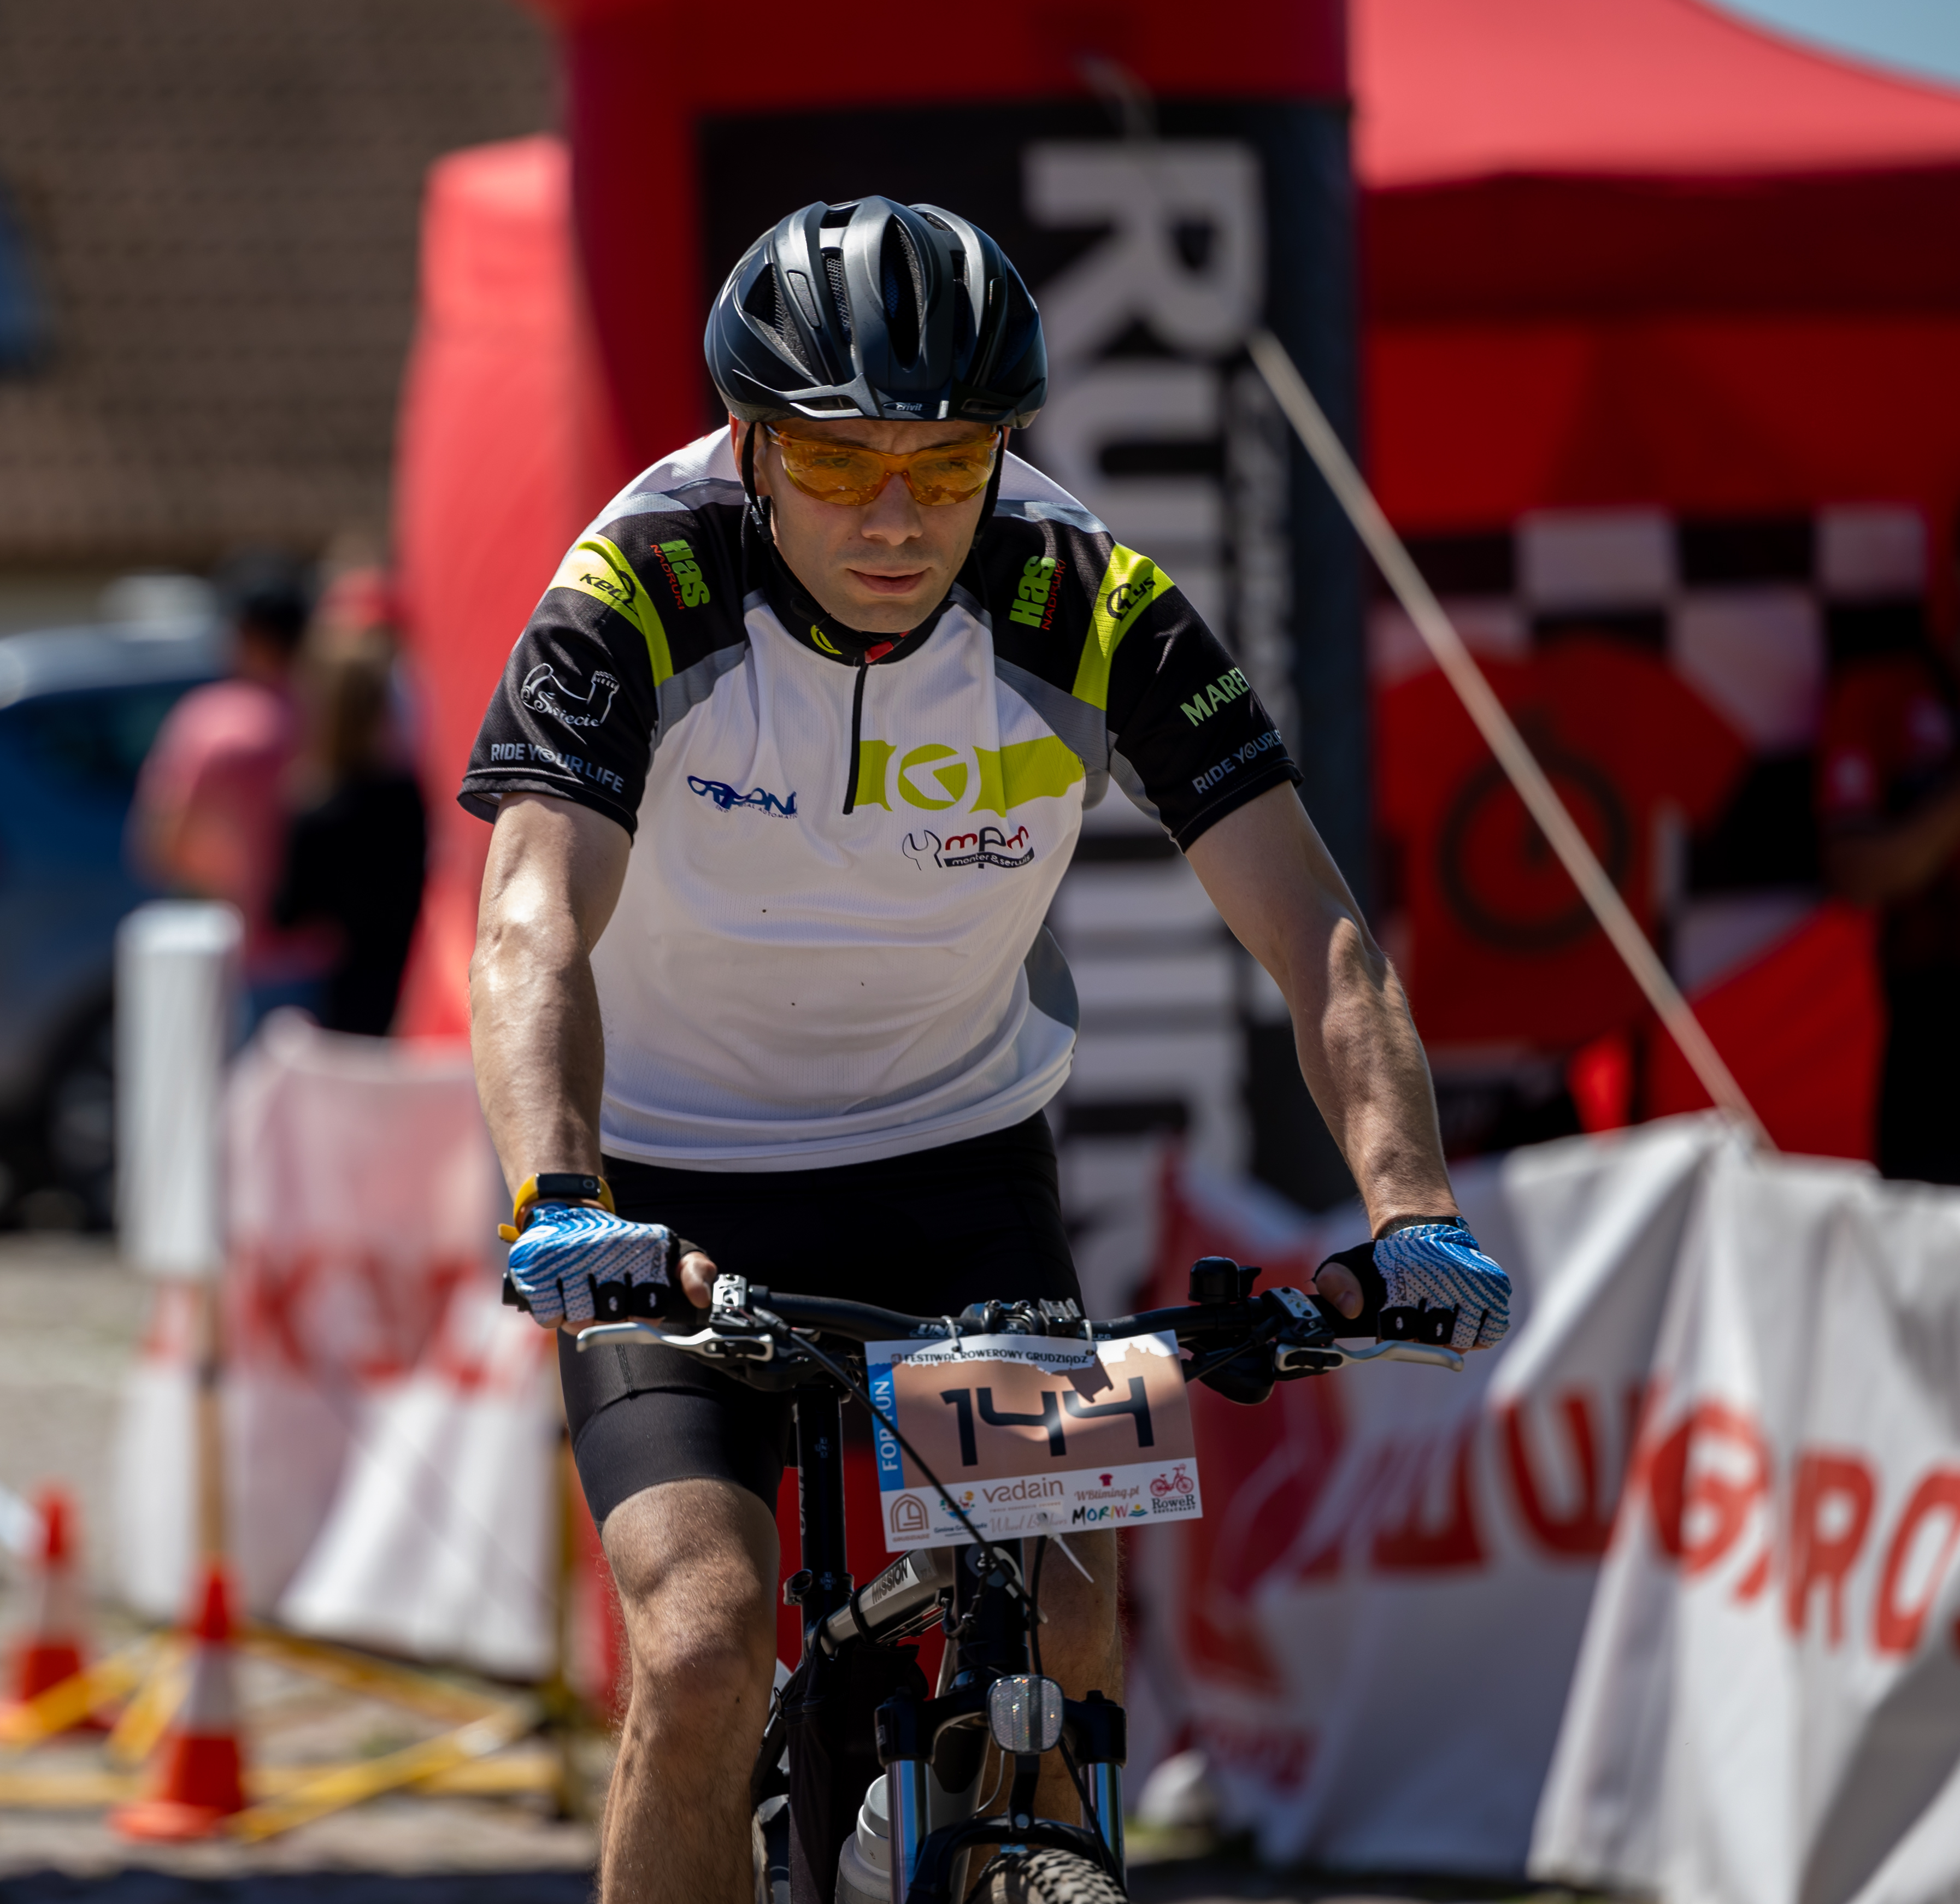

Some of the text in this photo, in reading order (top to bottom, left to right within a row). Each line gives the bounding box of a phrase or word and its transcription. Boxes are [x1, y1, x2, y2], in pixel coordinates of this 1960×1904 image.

[650, 545, 685, 610] NADRUKI
[1041, 559, 1067, 630] NADRUKI
[491, 743, 625, 793] RIDE YOUR LIFE
[1192, 758, 1236, 794] RIDE
[1232, 733, 1274, 764] YOUR
[905, 1353, 958, 1364] FESTIWAL
[961, 1348, 1023, 1360] ROWEROWY
[879, 1427, 898, 1471] FOR
[940, 1376, 1155, 1467] 144
[872, 1557, 908, 1605] MISSION
